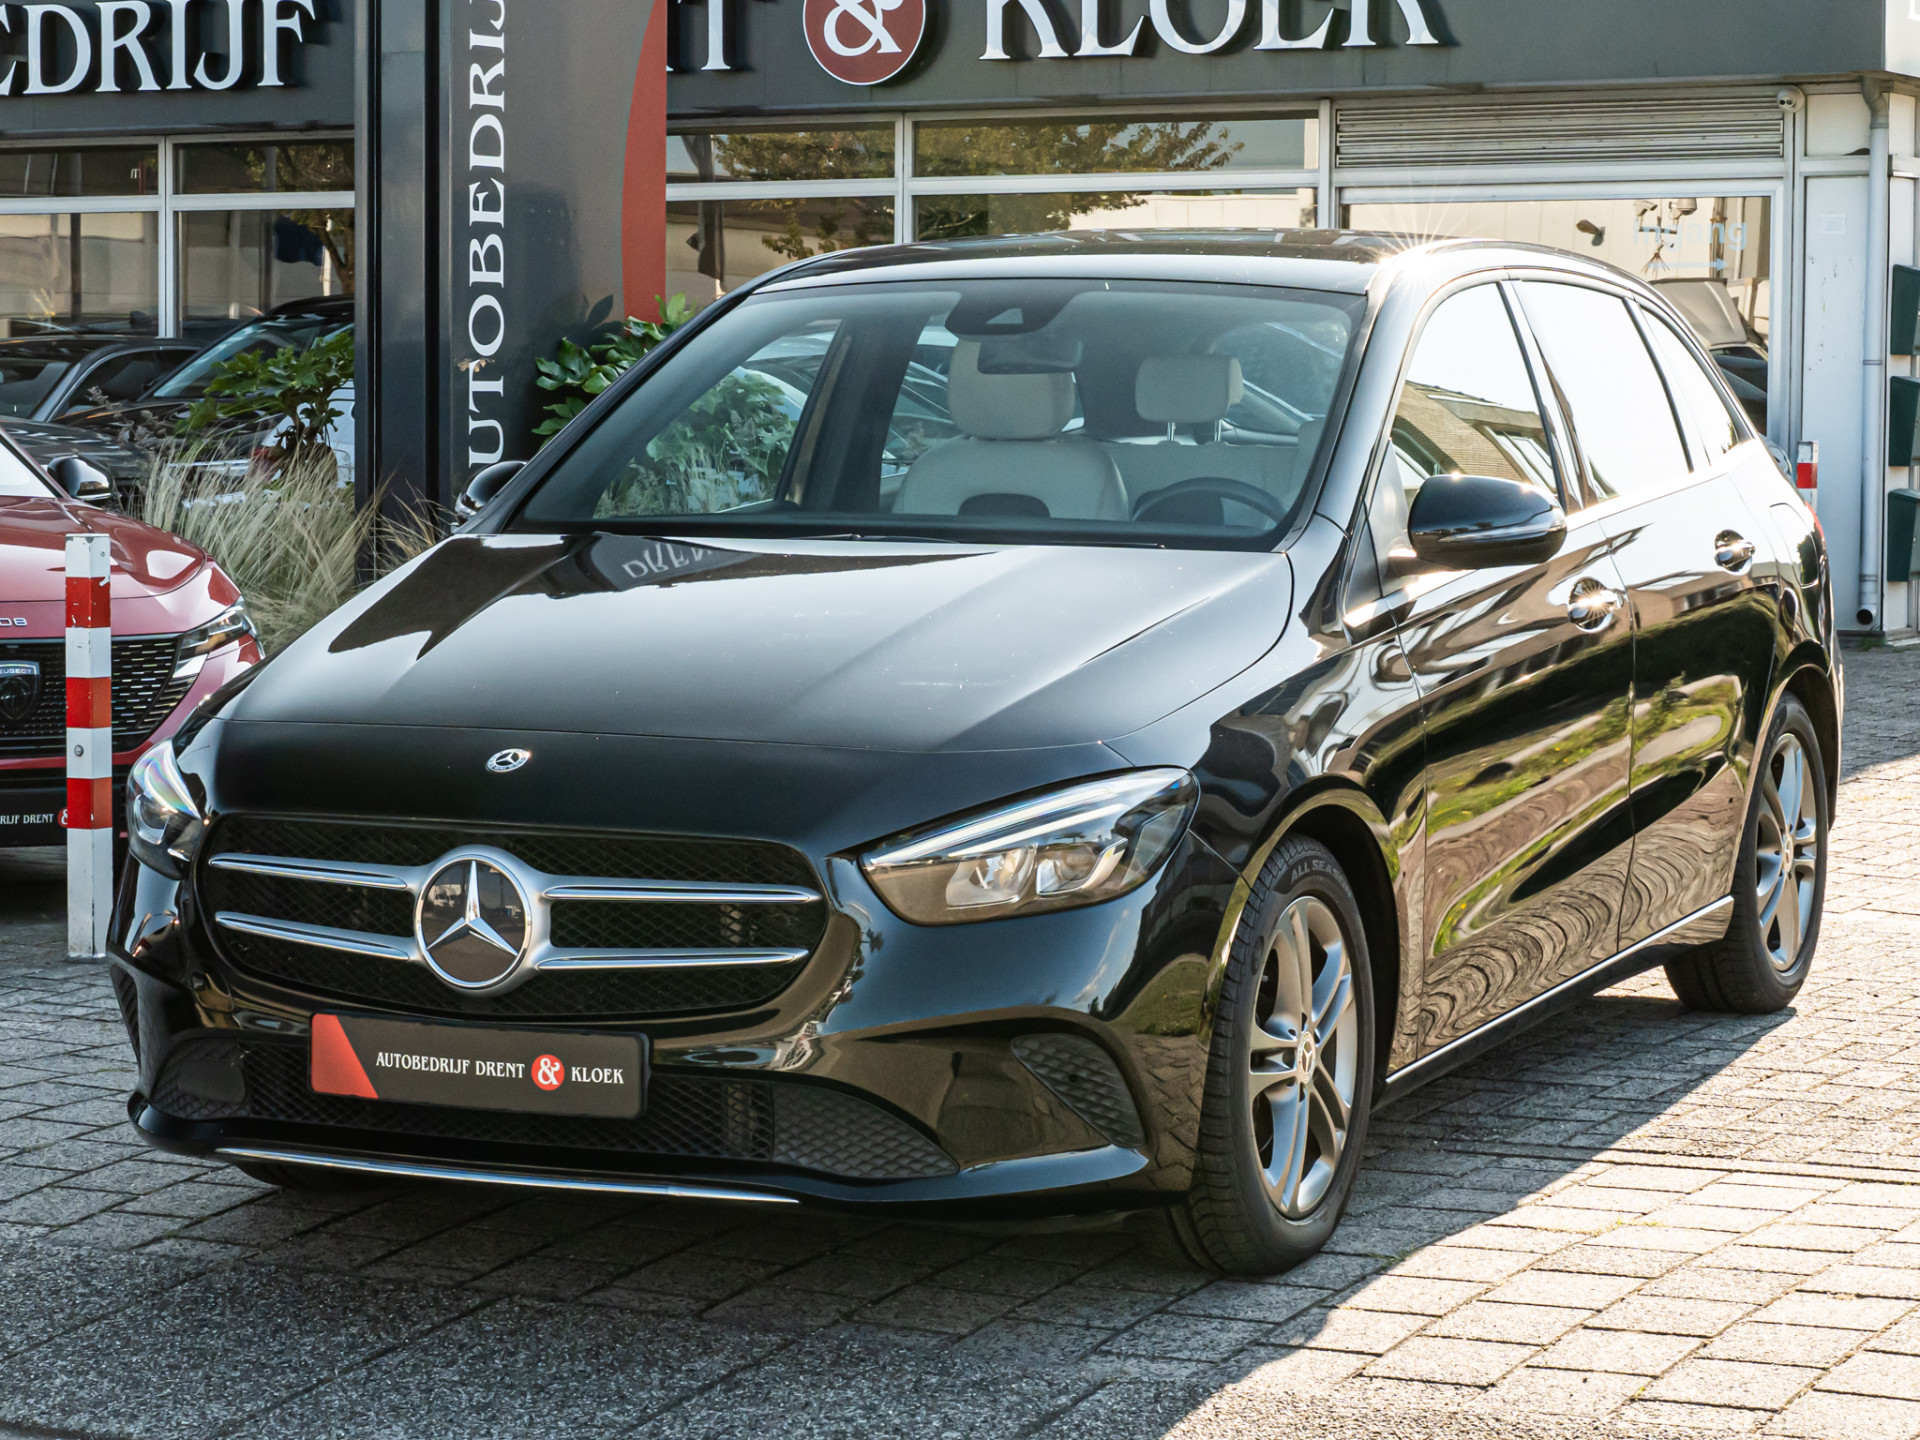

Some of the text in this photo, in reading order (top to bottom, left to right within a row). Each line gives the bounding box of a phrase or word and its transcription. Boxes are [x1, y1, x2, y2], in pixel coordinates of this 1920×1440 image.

[0, 0, 315, 96] DRIJF
[1633, 216, 1748, 251] Ingang
[23, 813, 54, 824] DRENT
[1291, 861, 1310, 885] ALL
[376, 1052, 624, 1085] AUTOBEDRIJF DRENT & KLOEK
